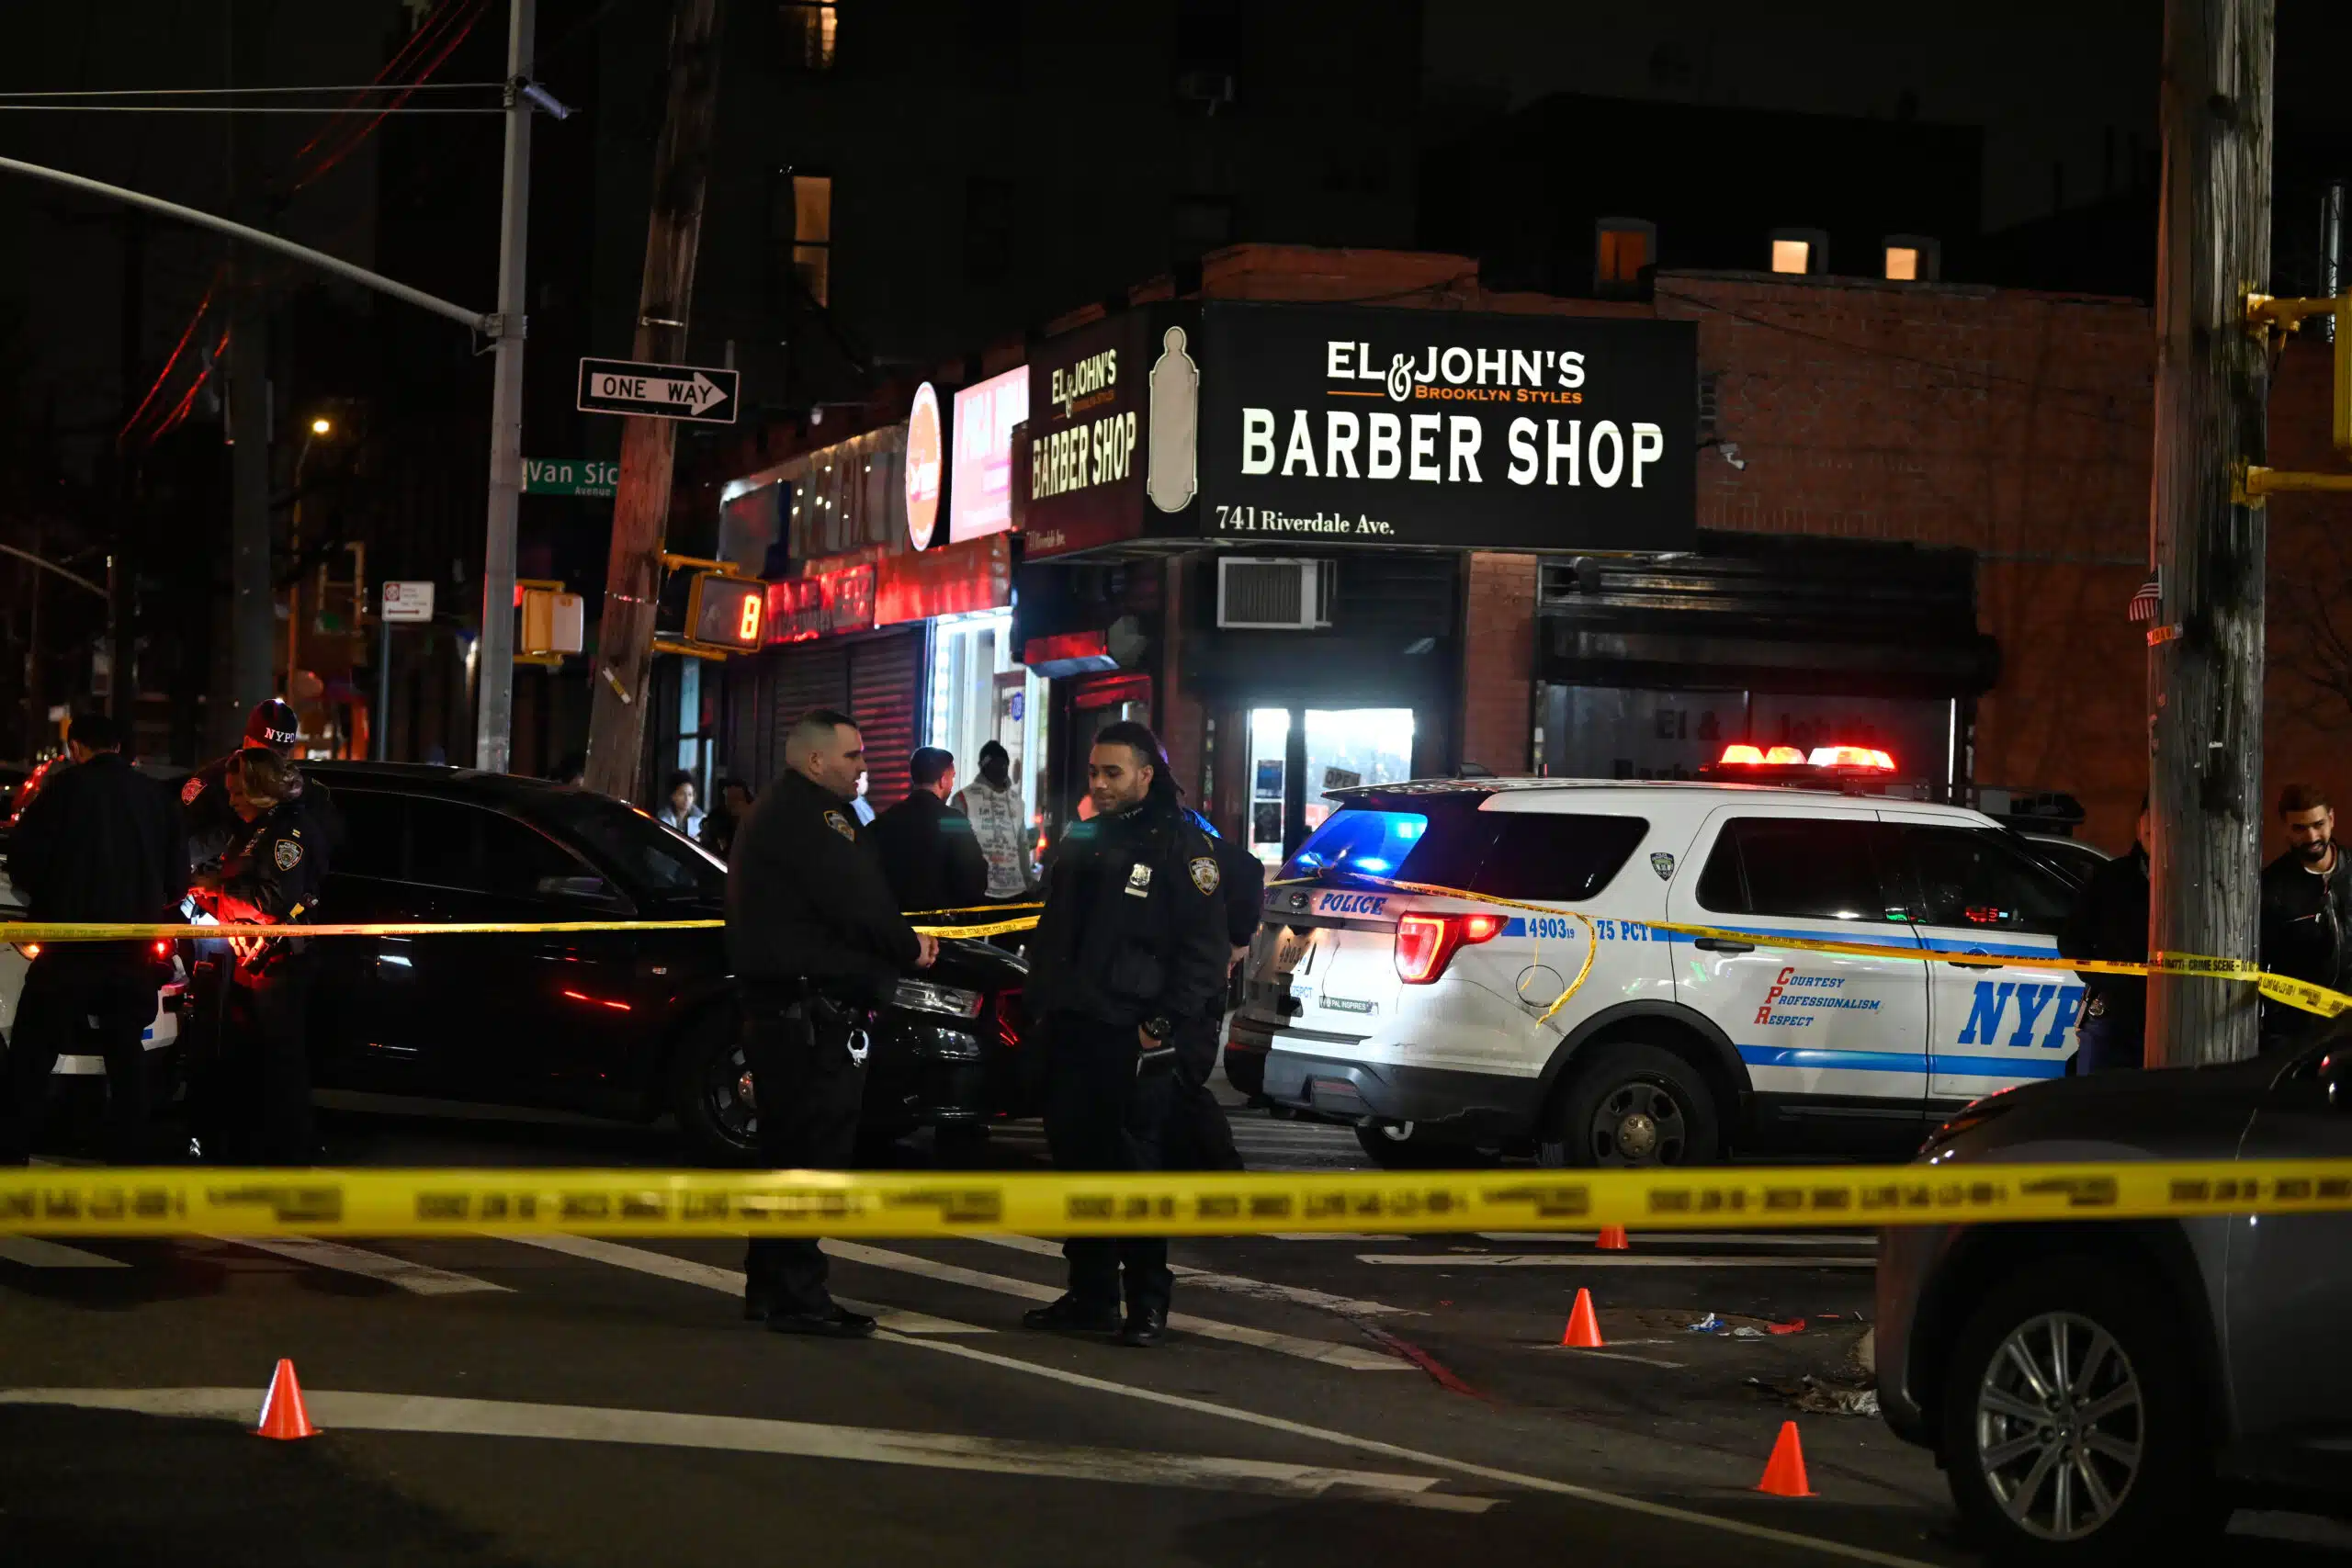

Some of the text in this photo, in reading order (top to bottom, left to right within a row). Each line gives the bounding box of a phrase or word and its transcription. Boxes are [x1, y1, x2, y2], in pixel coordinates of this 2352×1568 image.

[1072, 348, 1117, 397] JOHN'S
[1328, 341, 1385, 379] EL
[1415, 345, 1585, 388] JOHN'S
[603, 377, 713, 404] ONE WAY
[1415, 385, 1583, 404] BROOKLYN STYLES
[1032, 424, 1090, 500] BARBER
[1091, 412, 1137, 485] SHOP
[1240, 407, 1664, 489] BARBER SHOP
[528, 460, 574, 484] Van
[573, 485, 611, 497] Avenue
[1216, 505, 1395, 536] 741 Riverdale Ave.
[741, 593, 762, 639] 8
[264, 727, 296, 743] NYPD
[1319, 892, 1389, 916] POLICE
[1530, 918, 1566, 939] 4903
[1597, 919, 1614, 941] 75
[1621, 920, 1649, 942] PCT
[1776, 967, 1845, 988] COURTESY
[1765, 987, 1880, 1010] PROFESSIONALISM
[1754, 1007, 1814, 1027] RESPECT
